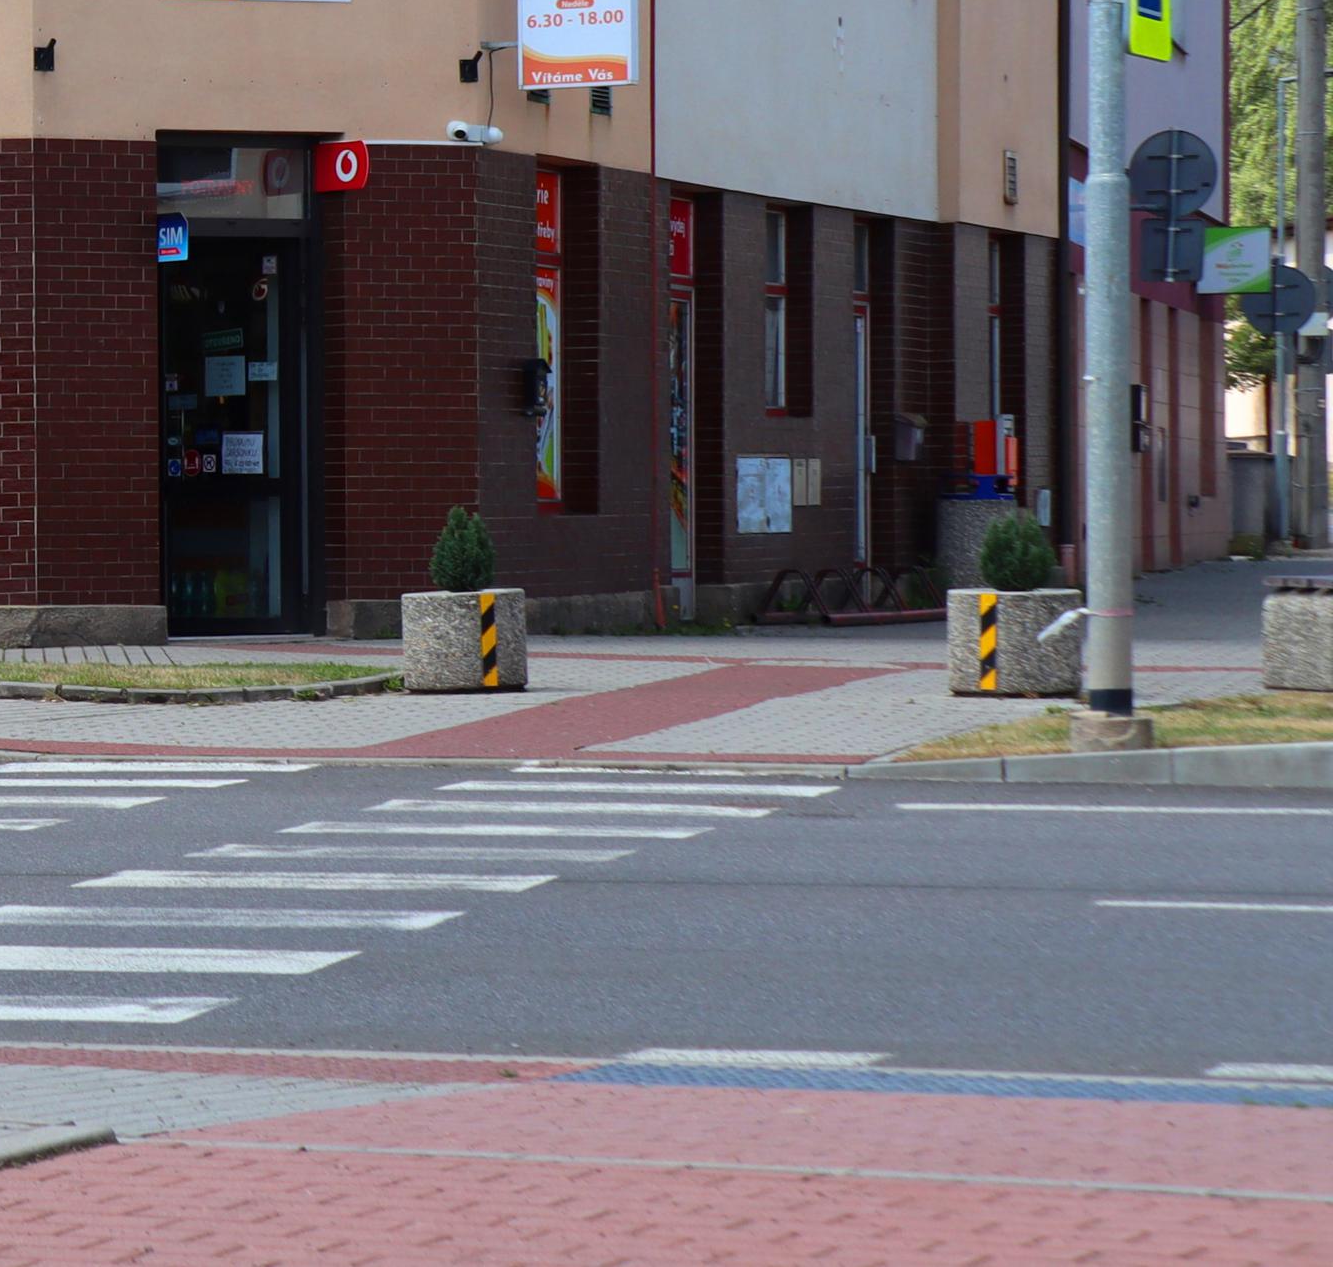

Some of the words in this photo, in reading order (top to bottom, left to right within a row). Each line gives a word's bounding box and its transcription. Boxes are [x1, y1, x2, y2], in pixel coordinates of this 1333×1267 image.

[526, 13, 563, 29] 6.30
[578, 9, 624, 26] 18.00
[532, 70, 583, 84] Vítáme
[588, 68, 614, 81] Vás
[158, 226, 183, 246] SIM
